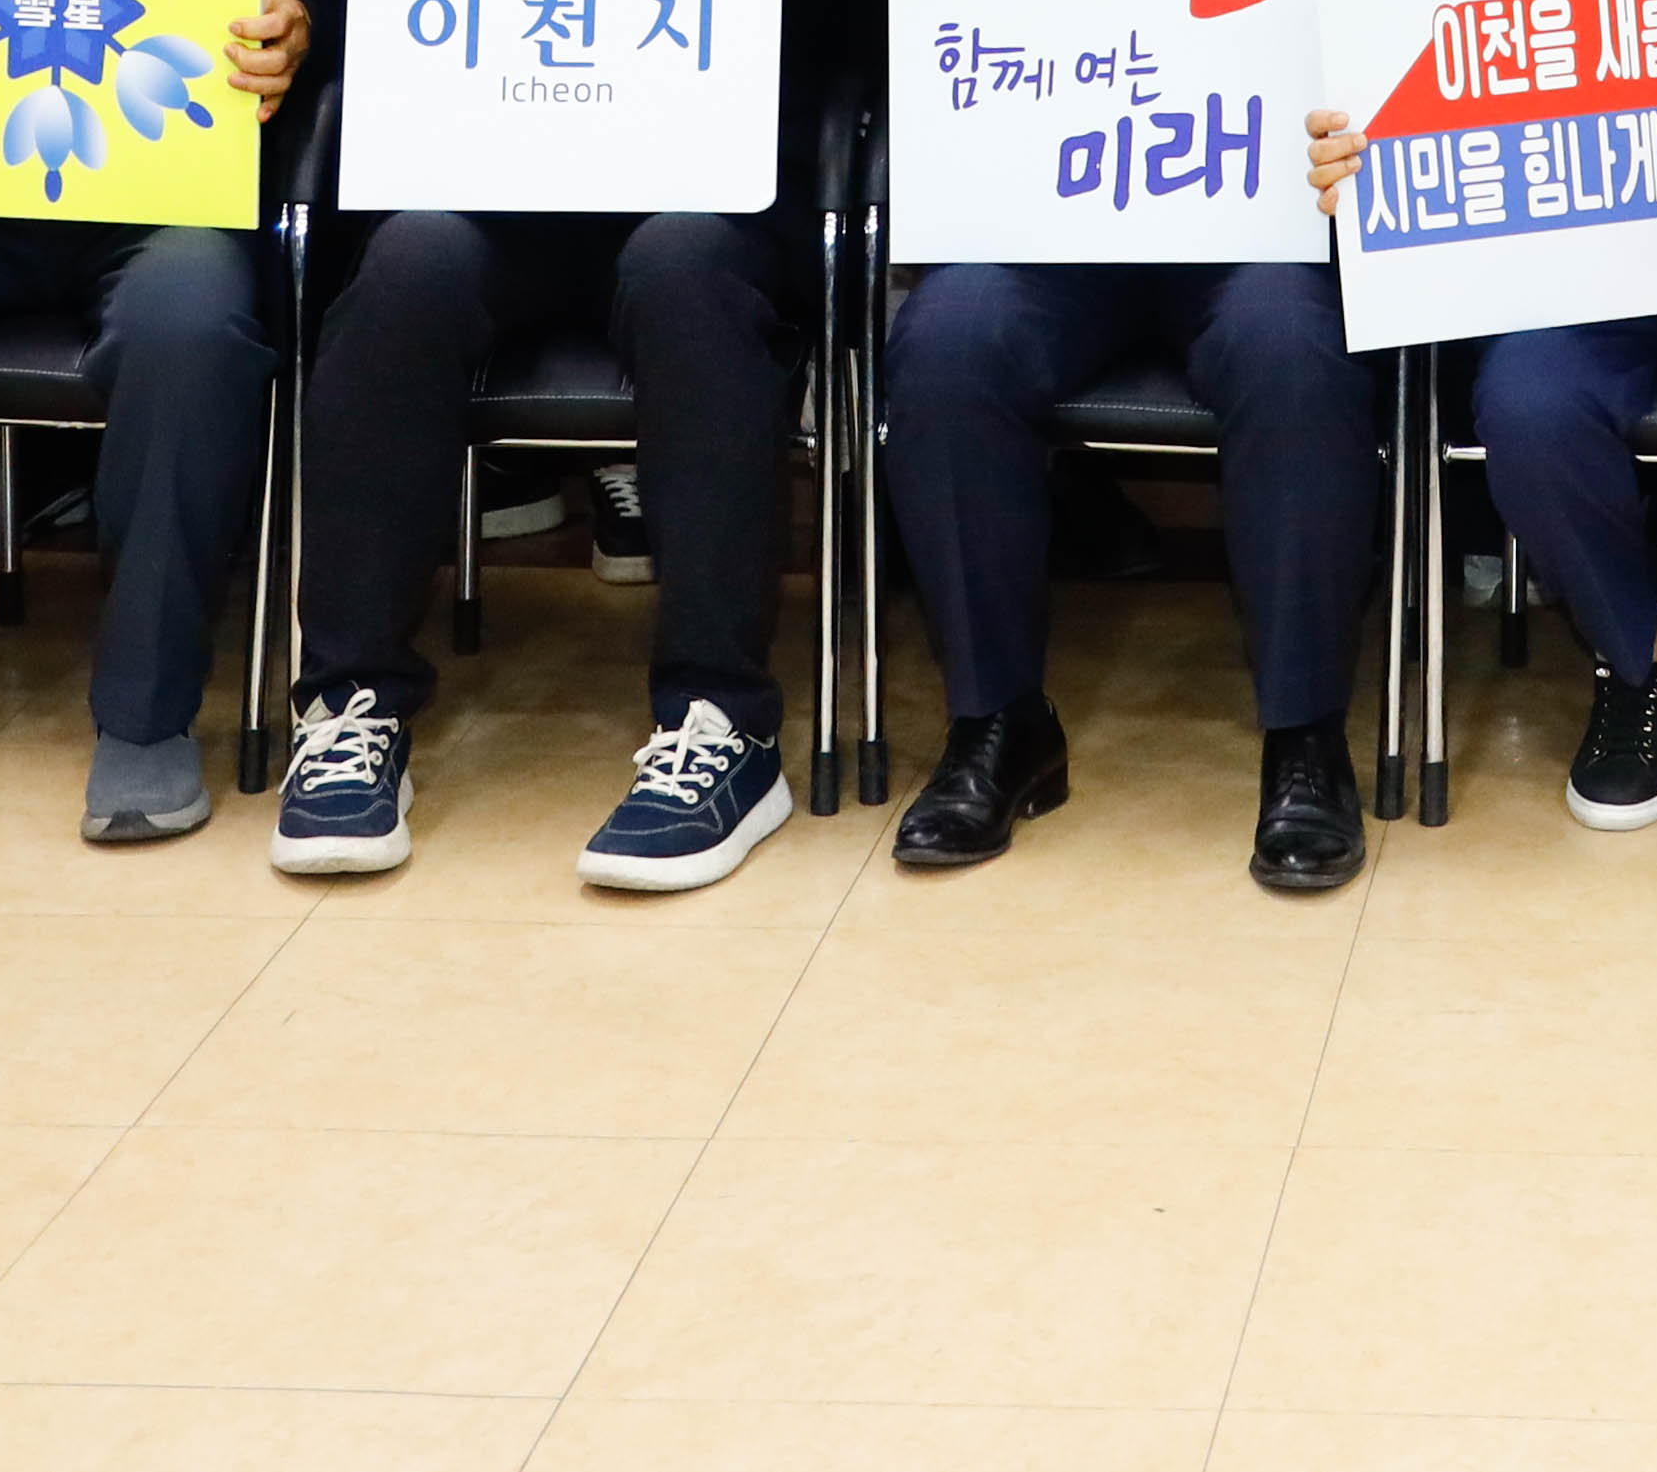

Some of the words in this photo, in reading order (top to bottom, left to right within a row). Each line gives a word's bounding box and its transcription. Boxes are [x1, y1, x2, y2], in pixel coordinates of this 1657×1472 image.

[501, 75, 614, 103] Icheon
[935, 22, 1055, 111] 함께
[1075, 28, 1160, 104] 여는
[1056, 91, 1263, 212] 미래
[1365, 129, 1508, 235] 시민을
